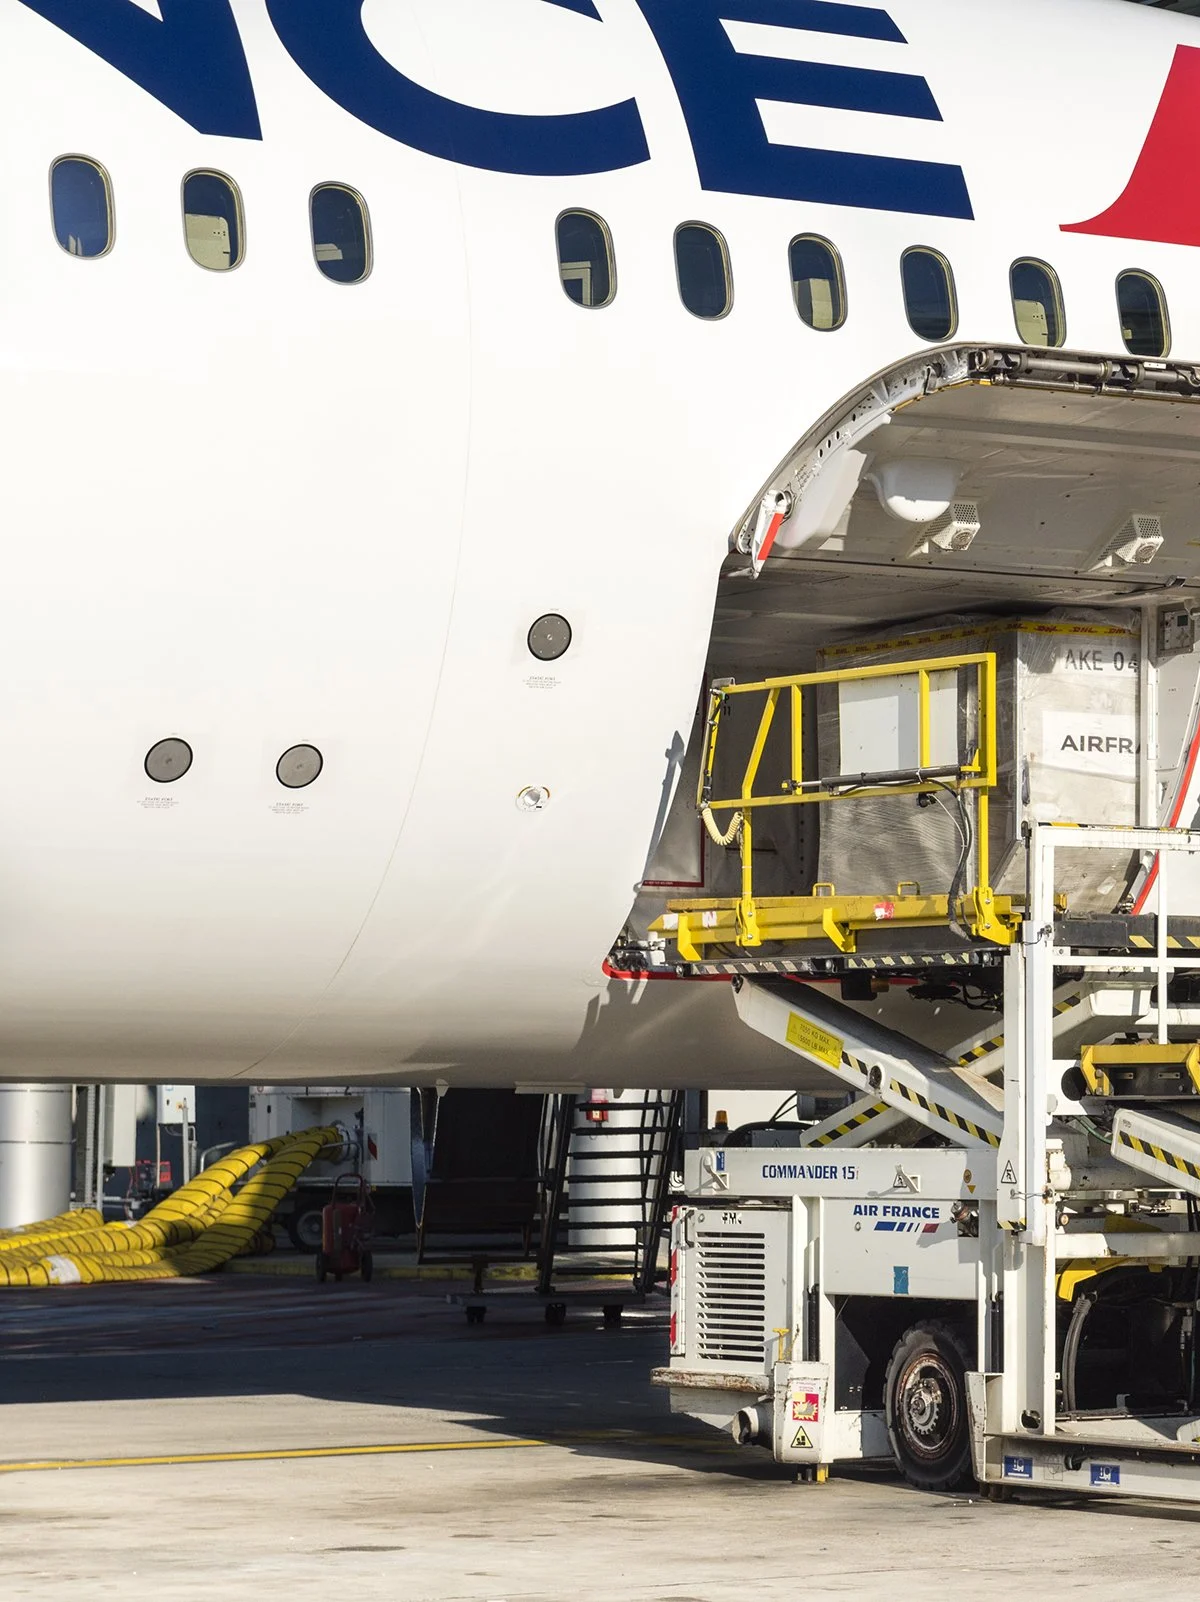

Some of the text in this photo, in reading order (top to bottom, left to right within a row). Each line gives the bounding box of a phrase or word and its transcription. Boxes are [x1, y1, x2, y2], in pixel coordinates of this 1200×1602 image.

[1065, 648, 1103, 671] AKE
[1061, 734, 1140, 754] AIRFR
[762, 1165, 838, 1179] COMMANDER
[853, 1204, 940, 1219] AIR FRANCE
